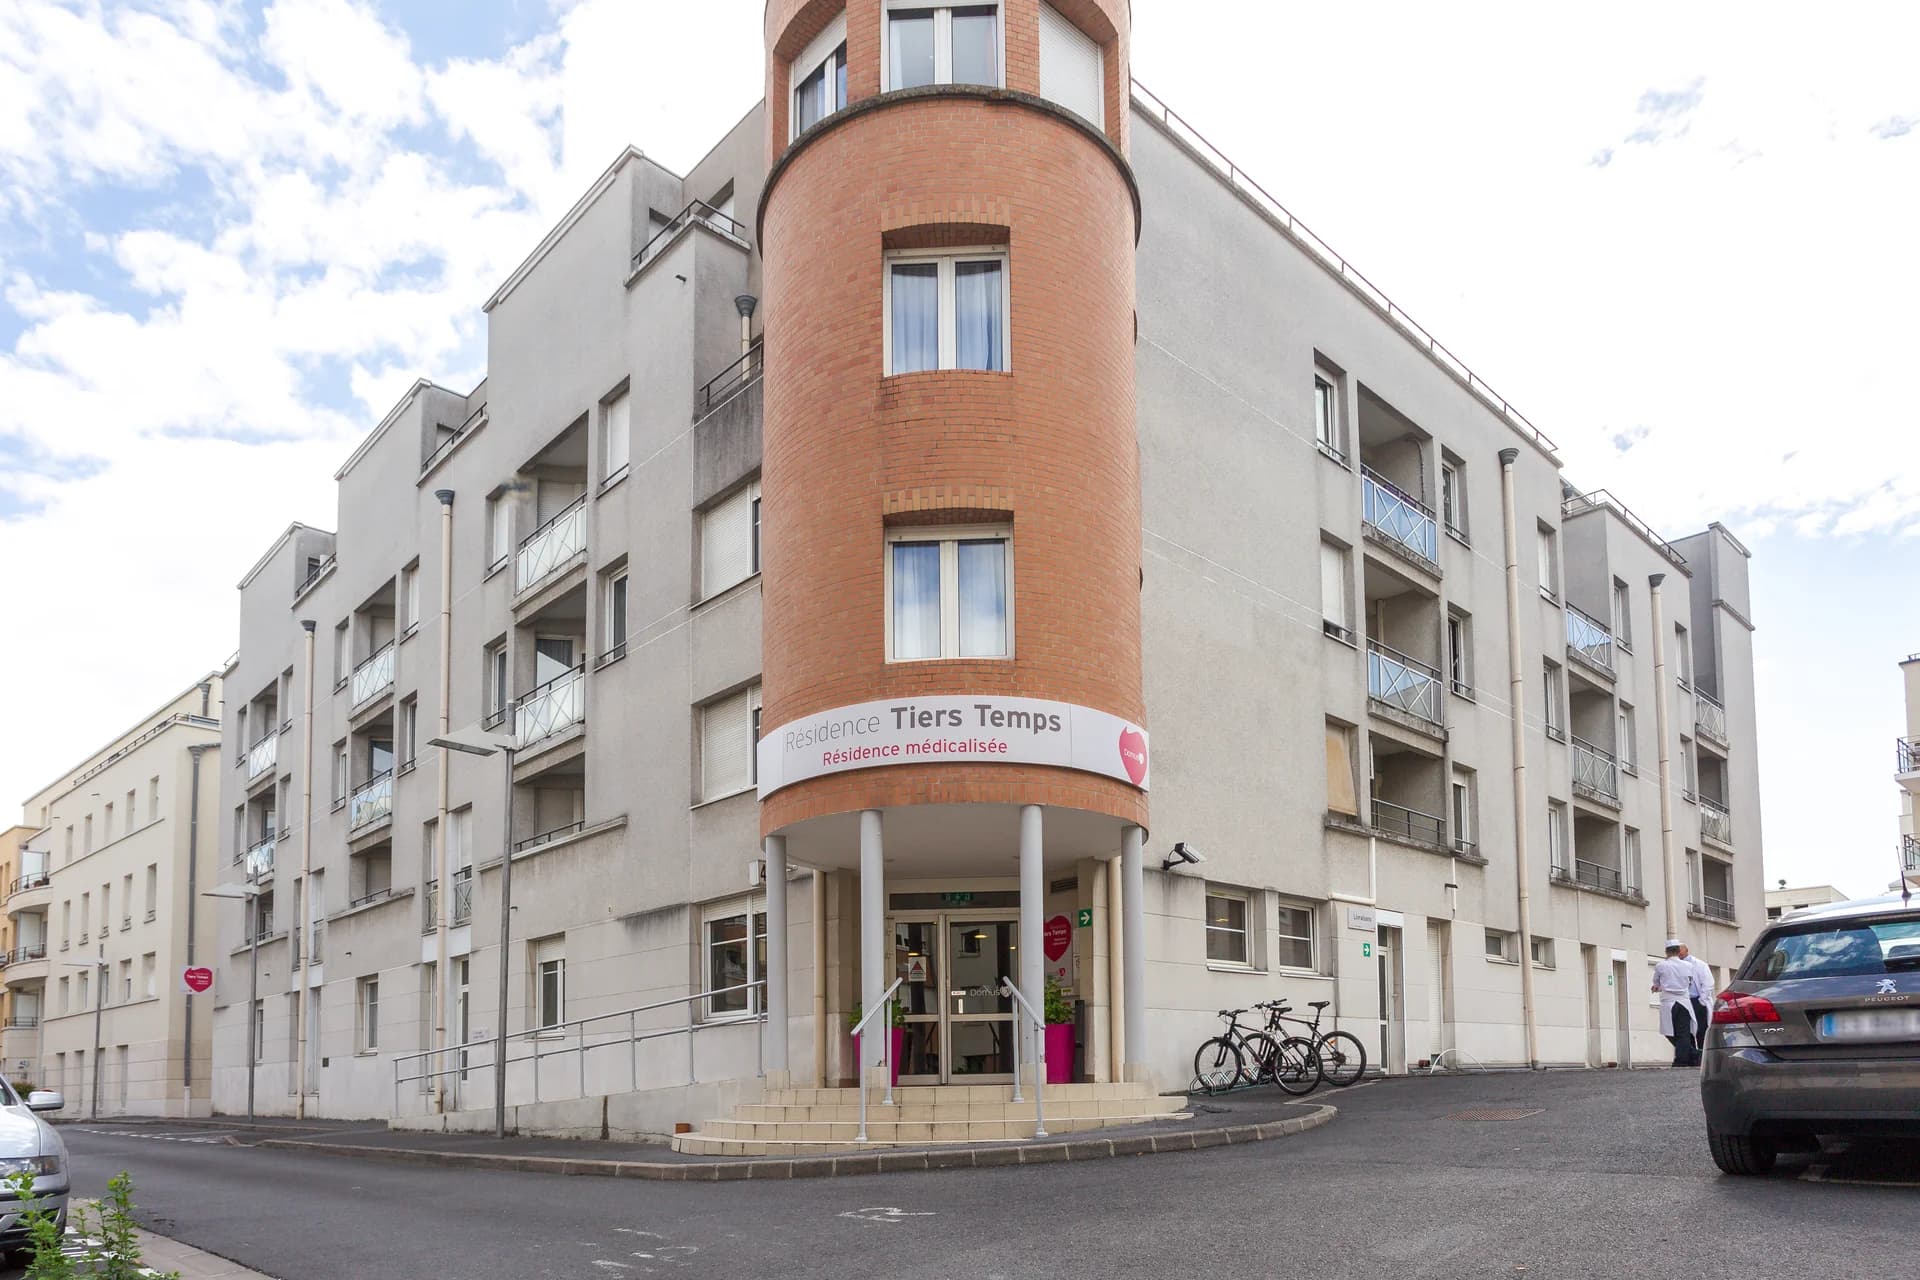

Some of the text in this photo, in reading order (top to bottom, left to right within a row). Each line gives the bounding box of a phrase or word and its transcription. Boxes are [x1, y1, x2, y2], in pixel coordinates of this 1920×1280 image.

[786, 704, 1061, 753] Résidence Tiers Temps
[823, 738, 1008, 766] Résidence médicalisée
[1864, 995, 1911, 1003] PEUGEOT
